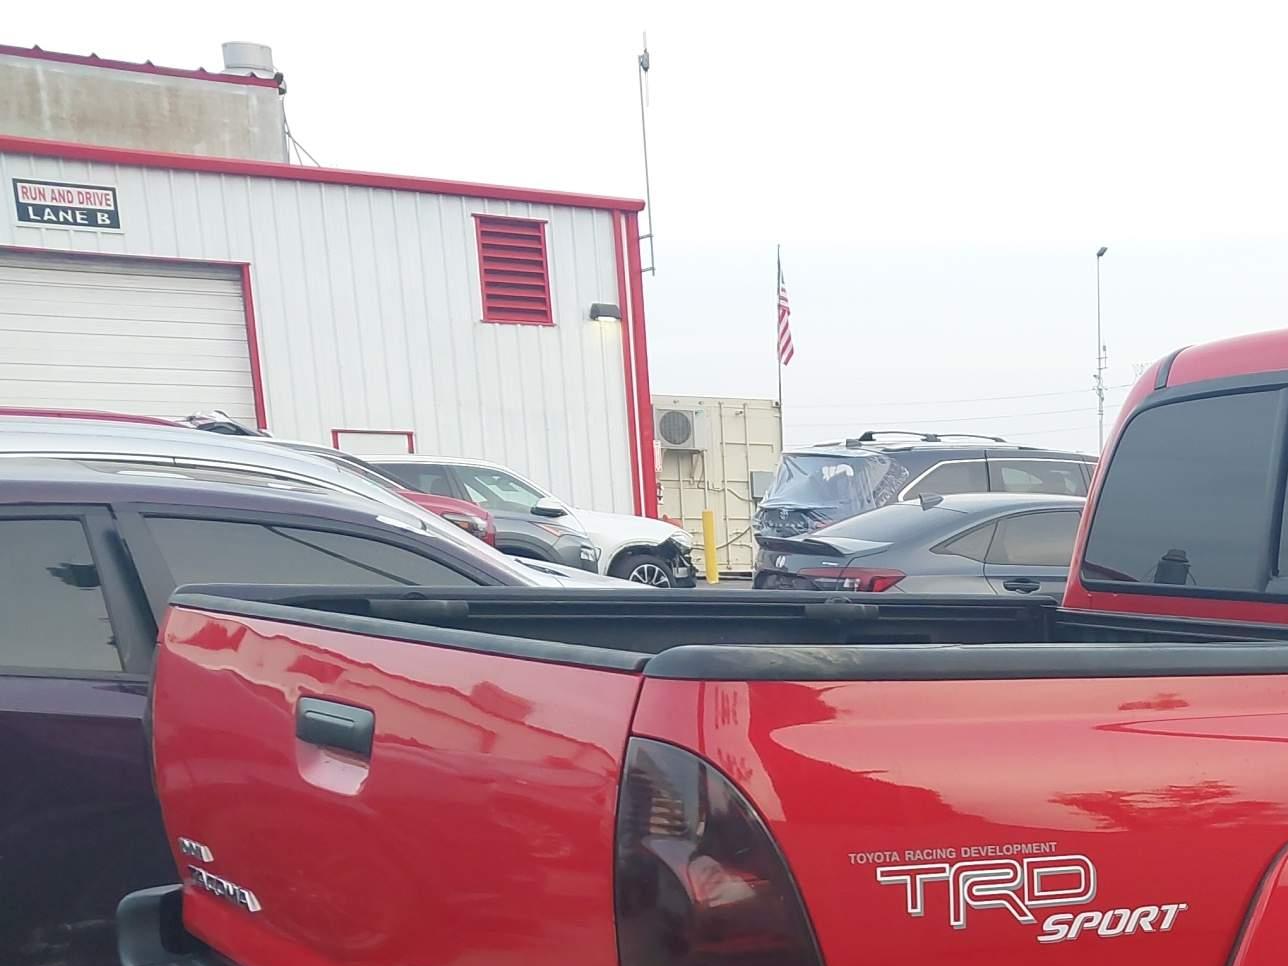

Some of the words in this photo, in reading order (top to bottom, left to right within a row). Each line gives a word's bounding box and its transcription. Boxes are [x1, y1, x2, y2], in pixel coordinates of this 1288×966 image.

[21, 185, 46, 202] RUN
[50, 189, 74, 204] AND
[76, 192, 112, 207] DRIVE
[28, 206, 89, 224] LANE
[96, 212, 111, 225] B
[848, 851, 900, 865] TOYOTA
[905, 848, 956, 862] RACING
[961, 842, 1057, 858] DEVELOPMENT
[876, 854, 1097, 929] TRD
[1037, 903, 1188, 943] SPORT
